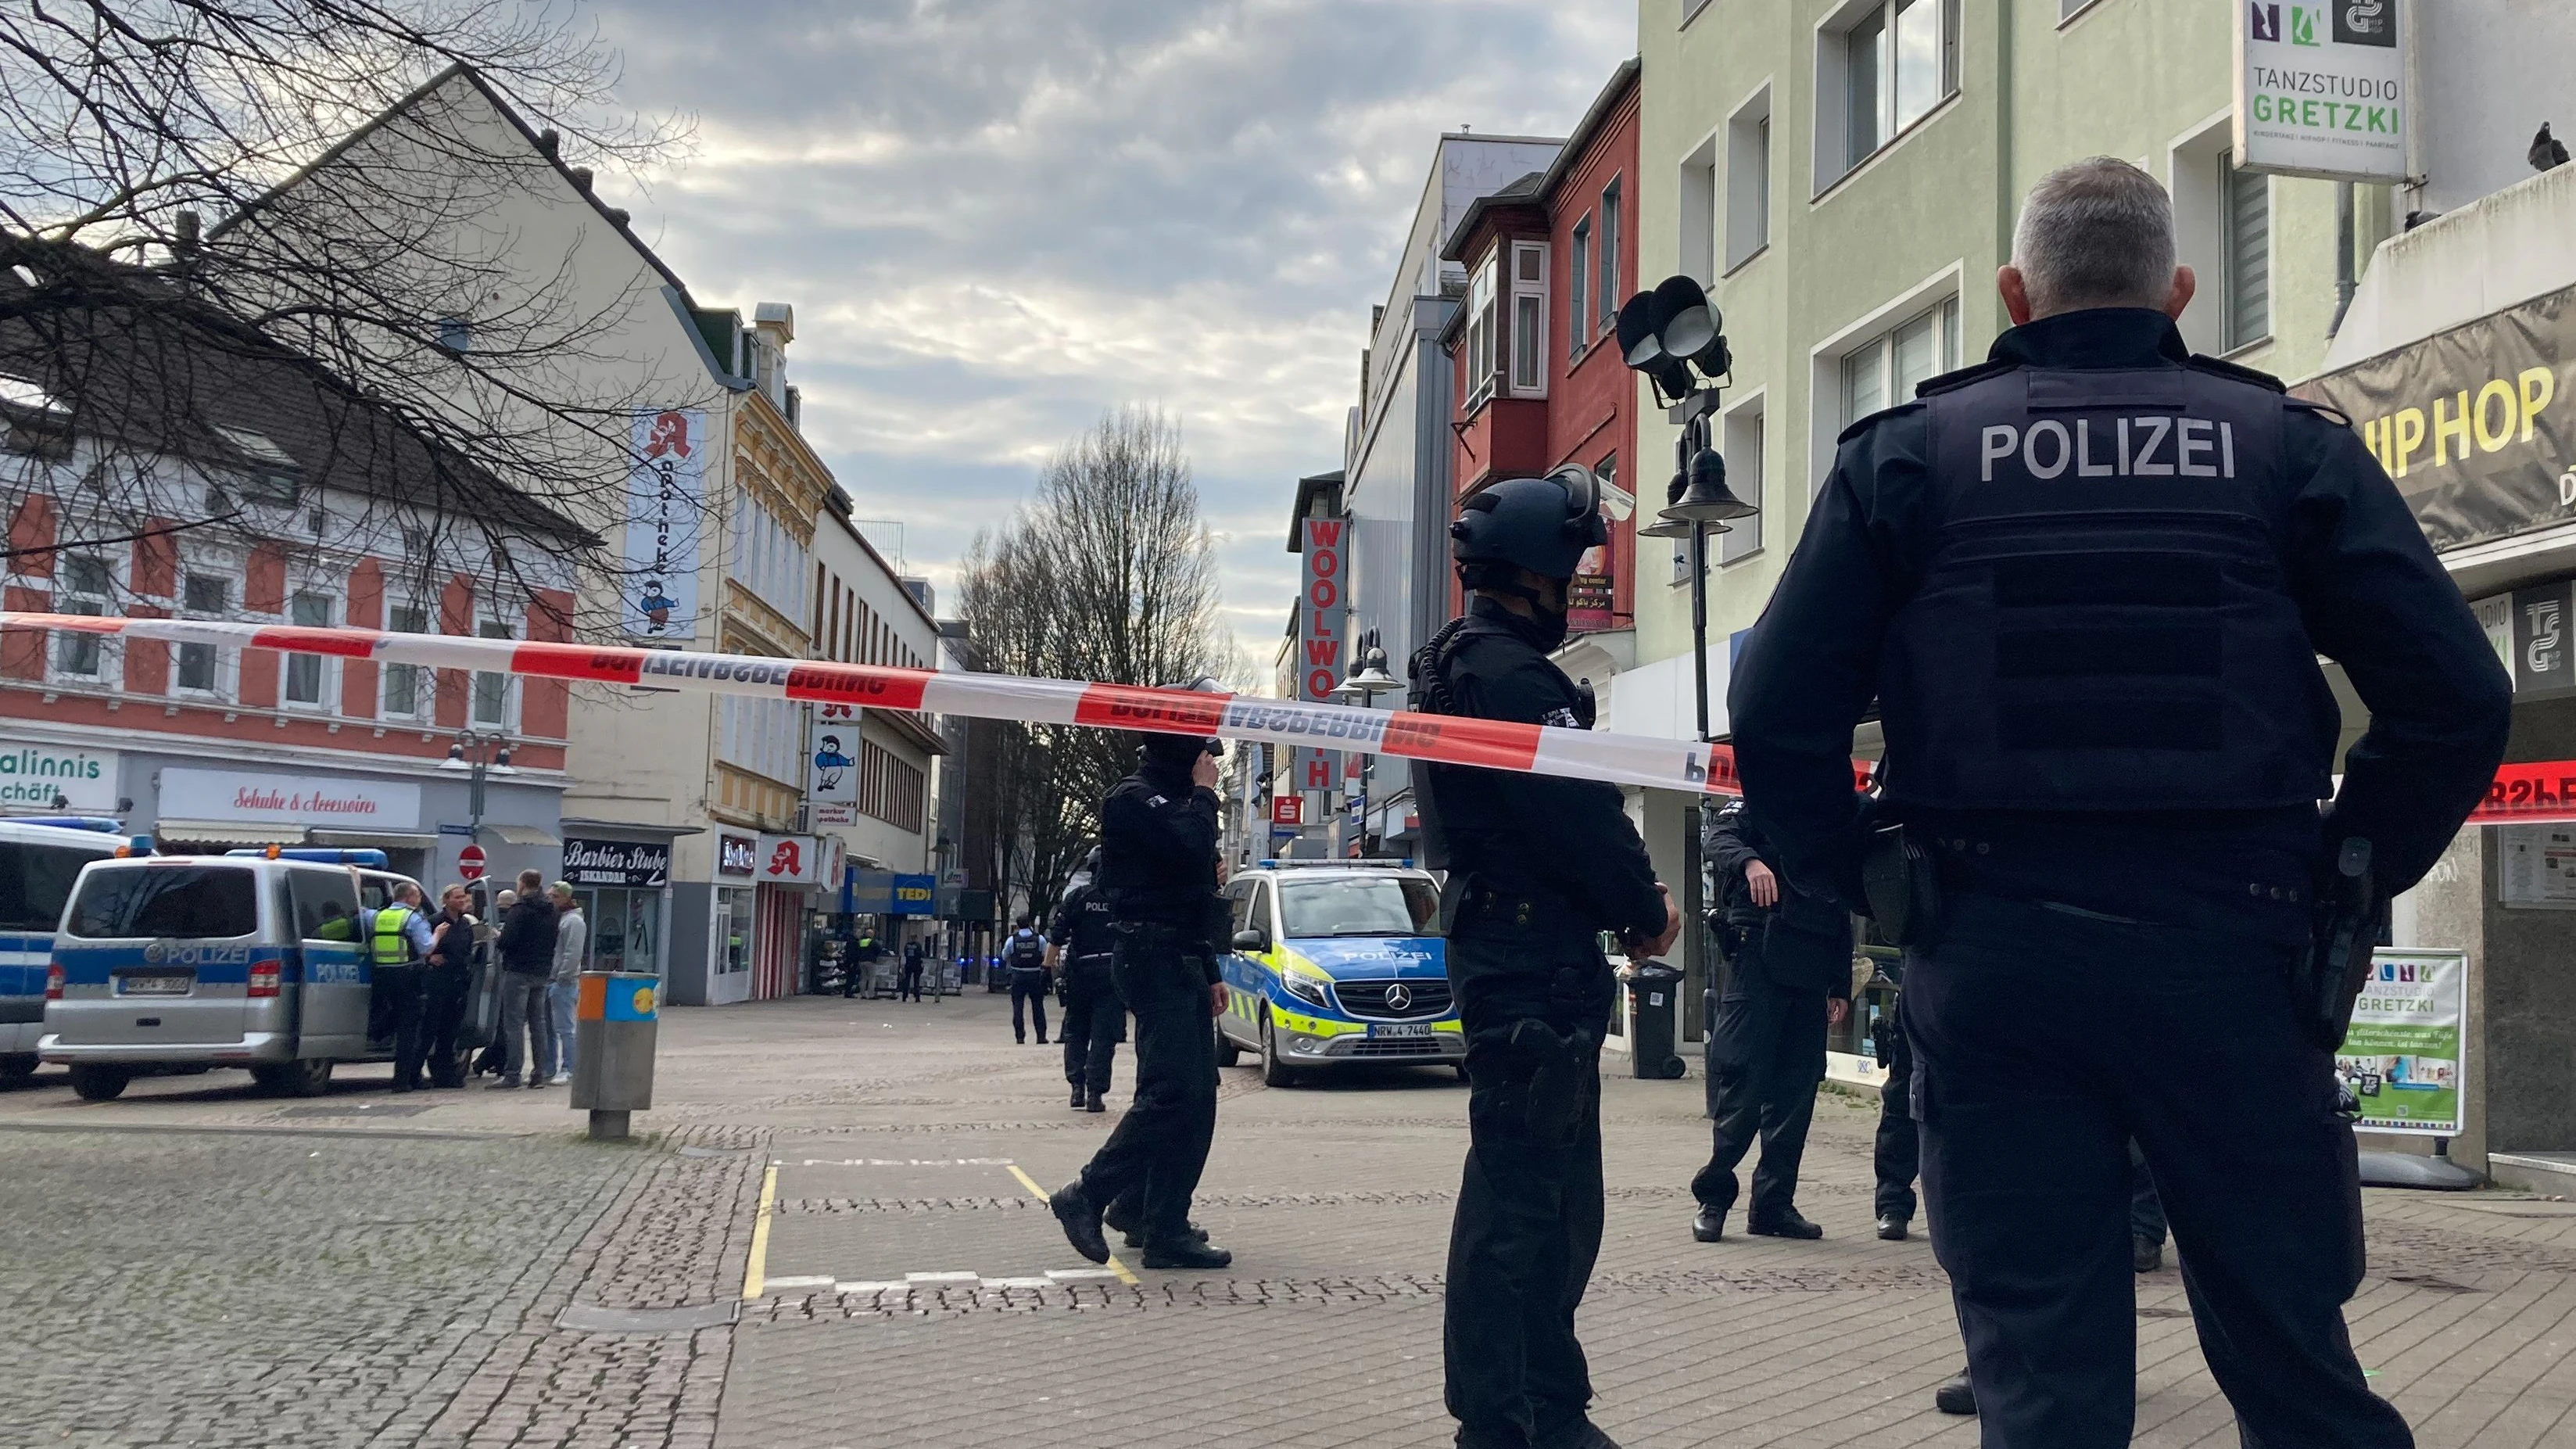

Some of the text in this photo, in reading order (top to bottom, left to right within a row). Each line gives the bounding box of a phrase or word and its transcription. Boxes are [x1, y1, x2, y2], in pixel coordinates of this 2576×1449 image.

[2253, 66, 2398, 101] TANZSTUDIO
[2253, 94, 2399, 134] GRETZKI
[2332, 138, 2359, 147] FITNESS
[1981, 416, 2235, 482] POLIZEI
[0, 749, 101, 780] alinnis
[234, 786, 286, 811] Schuhe
[303, 791, 377, 815] Accessoires
[564, 841, 667, 870] Barbier Stube
[166, 945, 251, 964] POLIZEI
[1344, 950, 1433, 961] POLIZEI
[2358, 997, 2434, 1013] GRETZKI
[1374, 1024, 1431, 1037] NRW 4 7440
